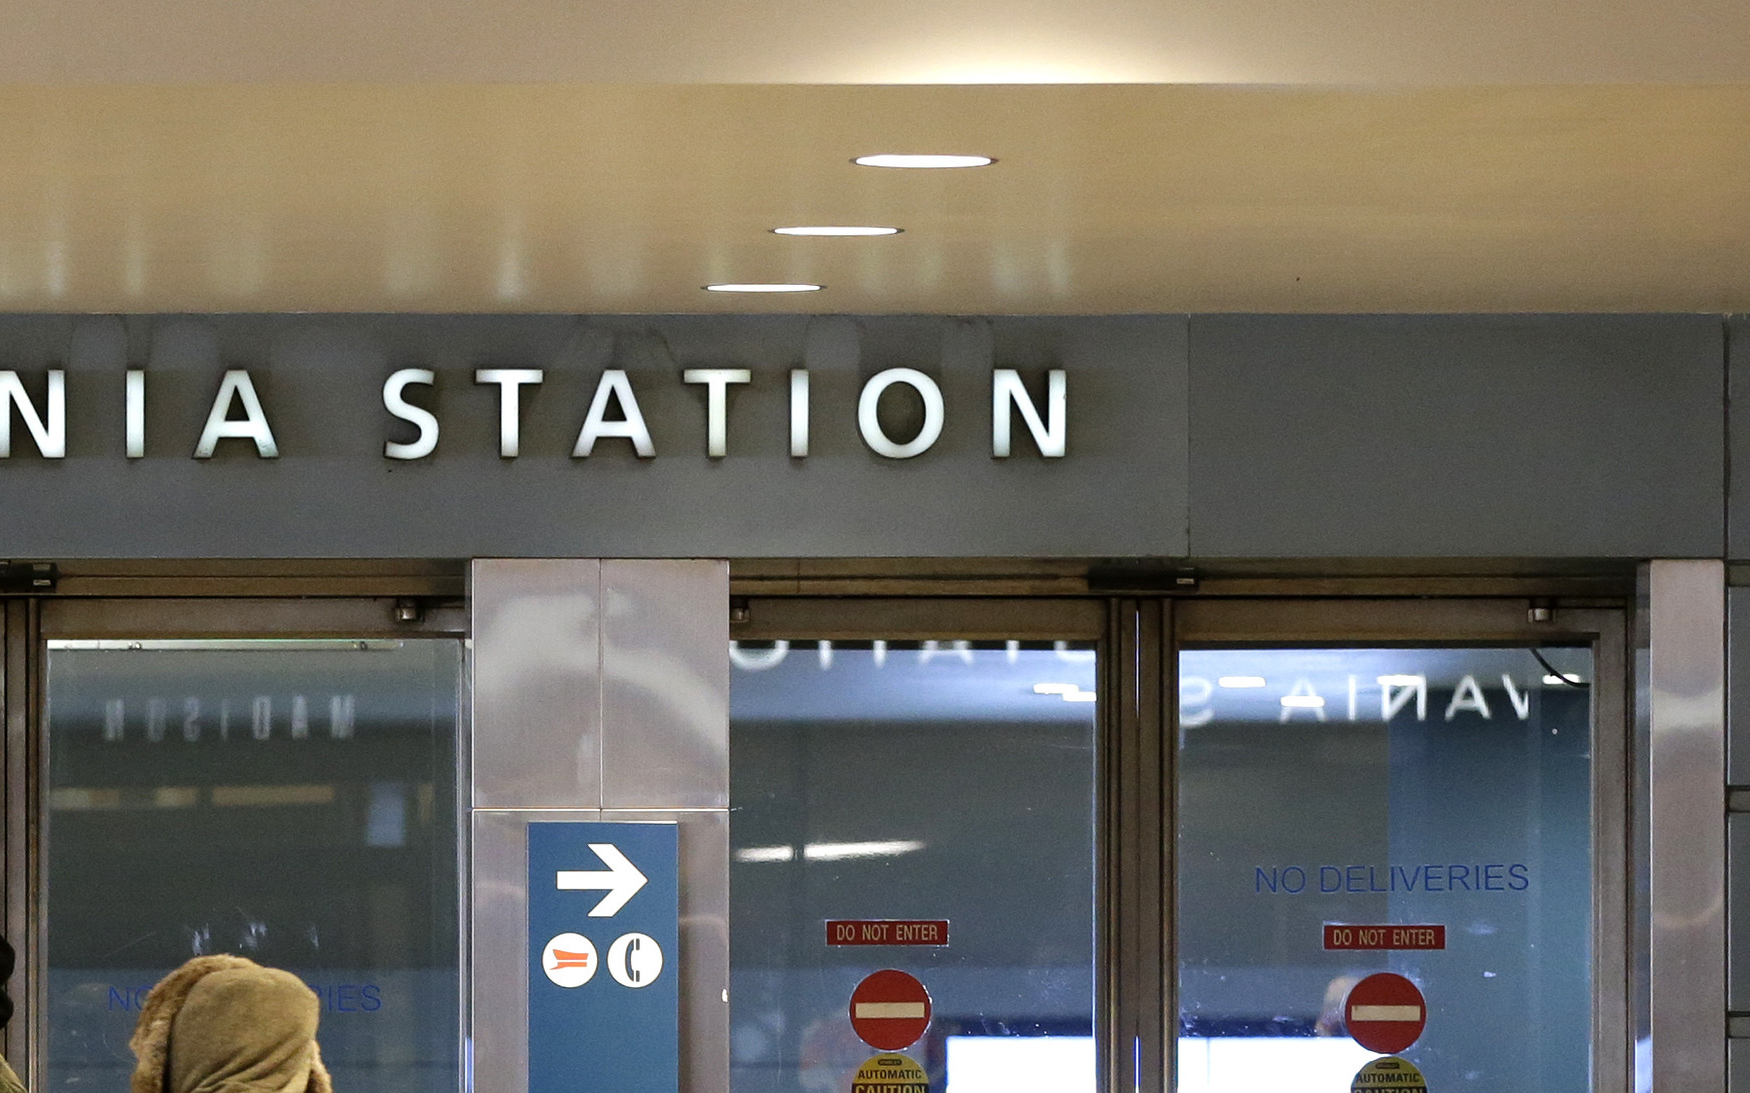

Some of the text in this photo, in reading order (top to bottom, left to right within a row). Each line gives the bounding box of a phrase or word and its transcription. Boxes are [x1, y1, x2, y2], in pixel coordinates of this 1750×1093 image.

[381, 367, 1067, 459] STATION
[1254, 864, 1530, 894] NO DELIVERIES
[836, 924, 938, 941] DO NOT ENTER
[1333, 929, 1435, 946] DO NOT ENTER
[858, 1069, 922, 1080] AUTOMATIC
[1356, 1072, 1420, 1083] AUTOMATIC
